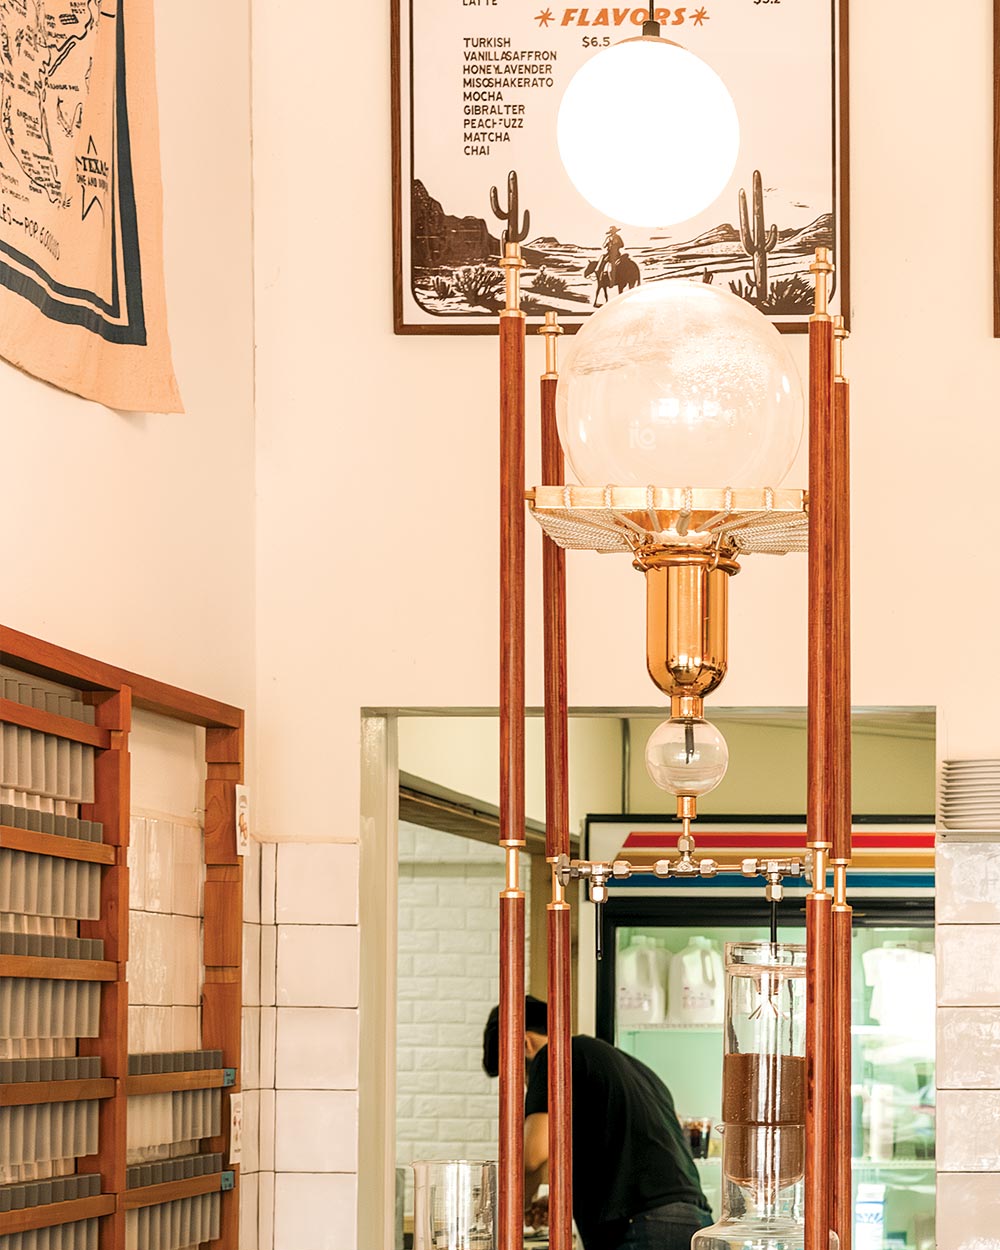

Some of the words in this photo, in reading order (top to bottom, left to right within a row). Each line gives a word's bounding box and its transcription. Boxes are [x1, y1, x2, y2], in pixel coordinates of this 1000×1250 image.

[560, 8, 687, 26] FLAVORS
[463, 37, 511, 48] TURKISH
[582, 36, 611, 48] $6.5
[463, 91, 504, 102] MOCHA
[464, 105, 526, 116] GIBRALTER
[464, 132, 511, 143] MATCHA
[464, 146, 490, 156] CHAI
